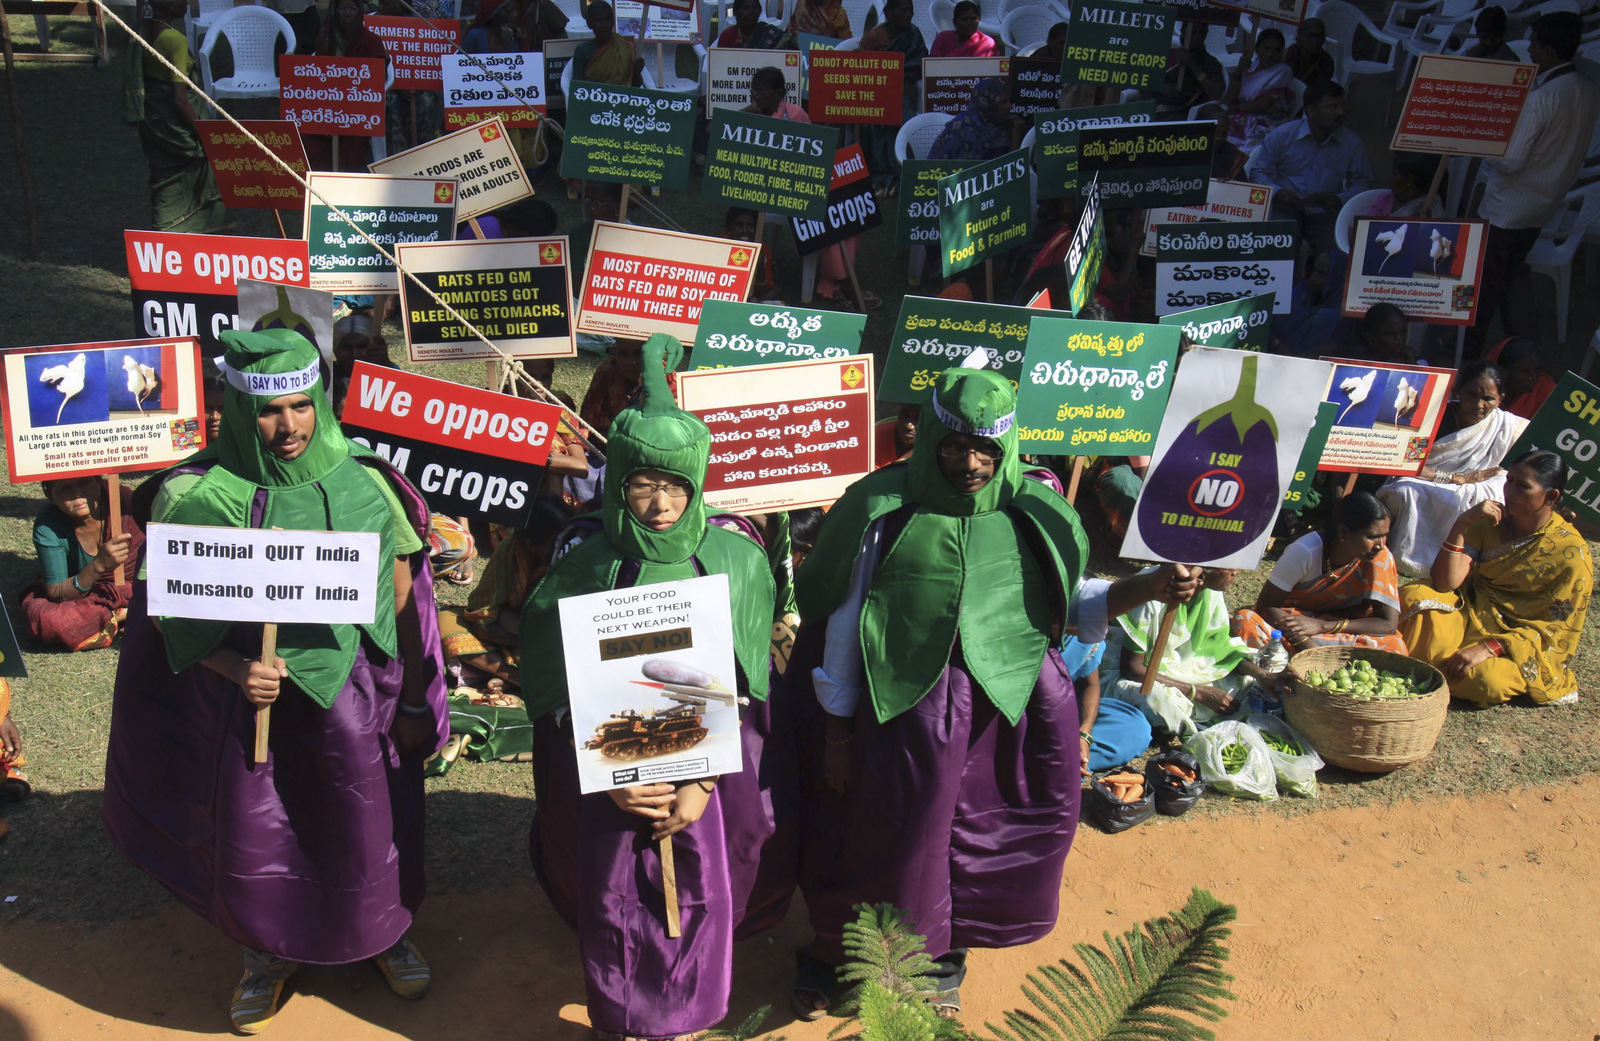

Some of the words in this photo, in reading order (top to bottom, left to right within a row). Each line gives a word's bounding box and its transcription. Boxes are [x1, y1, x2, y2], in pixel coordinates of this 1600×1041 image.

[1080, 6, 1166, 30] MILLETS
[418, 28, 456, 40] SHOULD
[1109, 36, 1129, 46] are
[402, 41, 420, 52] THE
[424, 42, 453, 53] RIGHT
[813, 57, 841, 68] DONOT
[843, 58, 879, 69] POLLUTE
[882, 59, 899, 70] OUR
[1067, 46, 1097, 61] PEST
[1099, 49, 1128, 64] FREE
[1130, 53, 1167, 69] CROPS
[727, 67, 739, 76] GM
[824, 74, 850, 84] SEEDS
[852, 75, 874, 85] WITH
[876, 76, 887, 85] BT
[1078, 68, 1108, 82] NEED
[1111, 71, 1128, 84] NO
[283, 85, 344, 101] పంటలను
[346, 86, 383, 102] మేము
[712, 80, 734, 89] MORE
[711, 94, 747, 103] CHILDREN
[835, 90, 856, 100] SAVE
[859, 91, 875, 101] THE
[590, 110, 621, 127] అనేక
[825, 106, 885, 117] ENVIRONMENT
[721, 123, 823, 157] MILLETS
[1147, 135, 1208, 155] చంపుతుంది
[426, 157, 461, 176] FOODS
[464, 149, 484, 164] ARE
[490, 156, 512, 172] FOR
[716, 149, 739, 164] MEAN
[740, 153, 778, 171] MULTIPLE
[779, 160, 825, 179] SECURITIES
[834, 153, 864, 177] want
[483, 170, 520, 191] ADULTS
[709, 165, 731, 182] FOOD,
[733, 170, 766, 188] FODDER,
[768, 176, 792, 193] FIBRE,
[794, 181, 826, 200] HEALTH,
[944, 157, 1026, 207] MILLETS
[721, 185, 767, 204] LIVELIHOOD
[769, 194, 775, 205] &
[777, 195, 809, 211] ENERGY
[981, 198, 994, 211] are
[828, 191, 876, 229] crops
[1167, 212, 1197, 222] EATING
[1211, 203, 1253, 218] MOTHERS
[966, 214, 998, 237] Future
[1000, 205, 1011, 222] of
[950, 242, 975, 264] Food
[977, 238, 985, 252] &
[988, 222, 1027, 247] Farming
[133, 241, 182, 275] We
[194, 251, 303, 285] oppose
[603, 257, 641, 274] MOST
[644, 262, 716, 285] OFFSPRING
[719, 273, 736, 287] OF
[438, 274, 473, 287] RATS
[478, 273, 504, 285] FED
[508, 271, 531, 283] GM
[591, 274, 624, 290] RATS
[627, 280, 652, 294] FED
[656, 285, 678, 298] GM
[680, 288, 706, 302] SOY
[434, 289, 507, 305] TOMATOES
[513, 288, 539, 301] GOT
[592, 293, 639, 311] WITHIN
[643, 300, 684, 317] THREE
[143, 300, 197, 337] GM
[411, 307, 479, 323] BLEEDING
[484, 304, 564, 320] STOMACHS,
[441, 324, 502, 338] SEVERAL
[506, 322, 538, 335] DIED
[248, 376, 251, 388] I
[253, 376, 270, 390] SAY
[273, 376, 287, 390] NO
[290, 376, 300, 388] TO
[360, 374, 412, 417] We
[424, 398, 549, 446] oppose
[792, 400, 846, 414] ఆహారం
[1095, 404, 1125, 419] పంట
[19, 434, 29, 442] All
[87, 428, 114, 437] picture
[141, 424, 154, 432] day
[155, 422, 169, 430] old.
[28, 442, 50, 450] Large
[52, 440, 67, 448] rats
[69, 438, 87, 446] were
[89, 436, 101, 444] fed
[103, 435, 119, 443] with
[121, 433, 146, 441] normal
[148, 431, 161, 440] Soy
[755, 427, 781, 440] వల్ల
[44, 452, 66, 461] Small
[68, 451, 84, 459] rats
[86, 449, 104, 457] were
[106, 447, 119, 455] fed
[136, 445, 148, 453] soy
[761, 445, 793, 458] ఉన్న
[1555, 428, 1598, 462] GO
[45, 460, 70, 469] Hence
[72, 458, 90, 467] their
[92, 455, 121, 464] smaller
[123, 453, 149, 462] growth
[1209, 452, 1216, 465] I
[1216, 454, 1242, 468] SAY
[724, 471, 755, 483] హాని
[420, 463, 529, 512] crops
[1194, 478, 1240, 508] NO
[1161, 512, 1177, 525] TO
[1178, 514, 1193, 527] Bt
[1194, 516, 1245, 533] BRINJAL
[167, 540, 190, 555] BT
[194, 541, 253, 559] Brinjal
[265, 545, 305, 561] QUIT
[316, 546, 360, 562] India
[167, 580, 253, 598] Monsanto
[265, 584, 305, 601] QUIT
[315, 586, 358, 601] India
[606, 595, 640, 606] YOUR
[643, 590, 676, 602] FOOD
[593, 610, 634, 622] COULD
[638, 607, 654, 616] BE
[656, 601, 692, 613] THEIR
[597, 623, 630, 635] NEXT
[632, 614, 690, 628] WEAPON!
[605, 638, 648, 656] SAY
[653, 630, 690, 648] NO!
